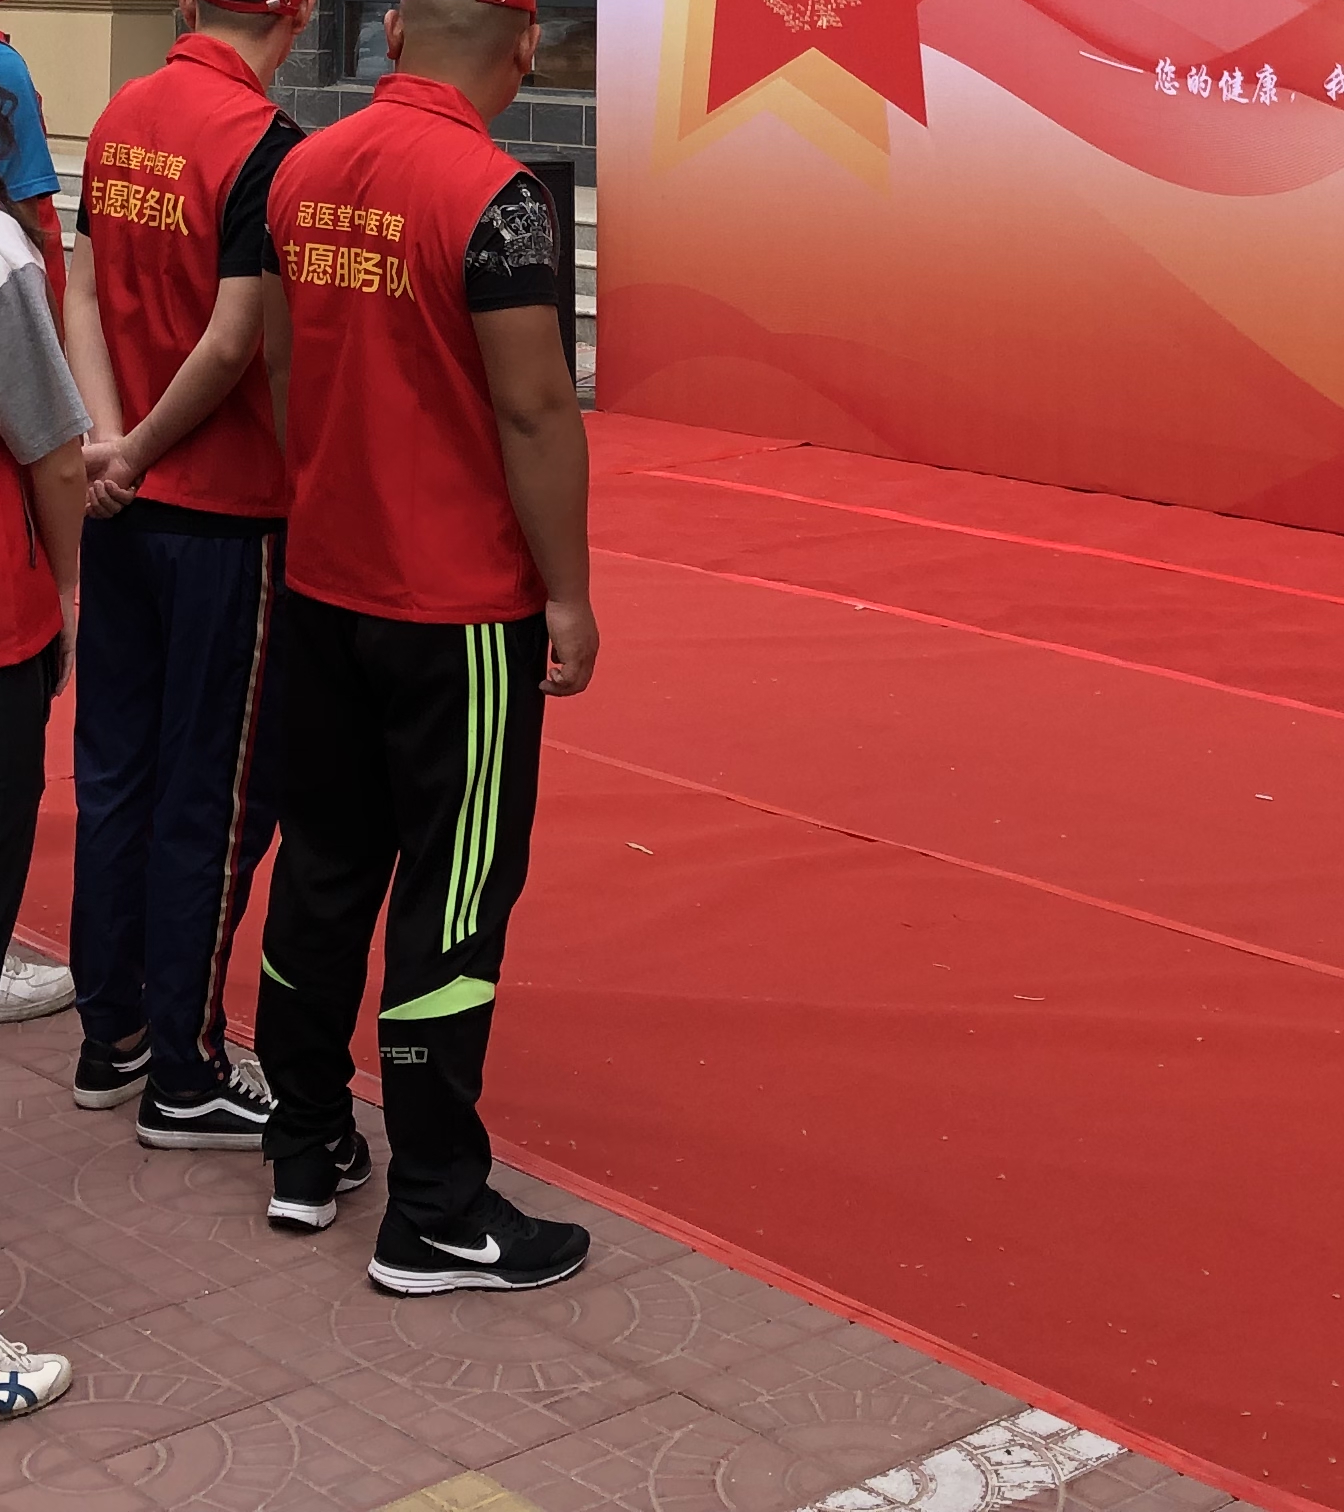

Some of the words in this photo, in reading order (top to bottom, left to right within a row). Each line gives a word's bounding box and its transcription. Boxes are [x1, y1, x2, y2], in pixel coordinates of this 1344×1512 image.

[100, 142, 187, 181] 冠医堂中医馆
[91, 176, 189, 237] 志愿服务队
[296, 201, 405, 243] 冠医堂中医馆
[282, 240, 416, 303] 志愿服务队
